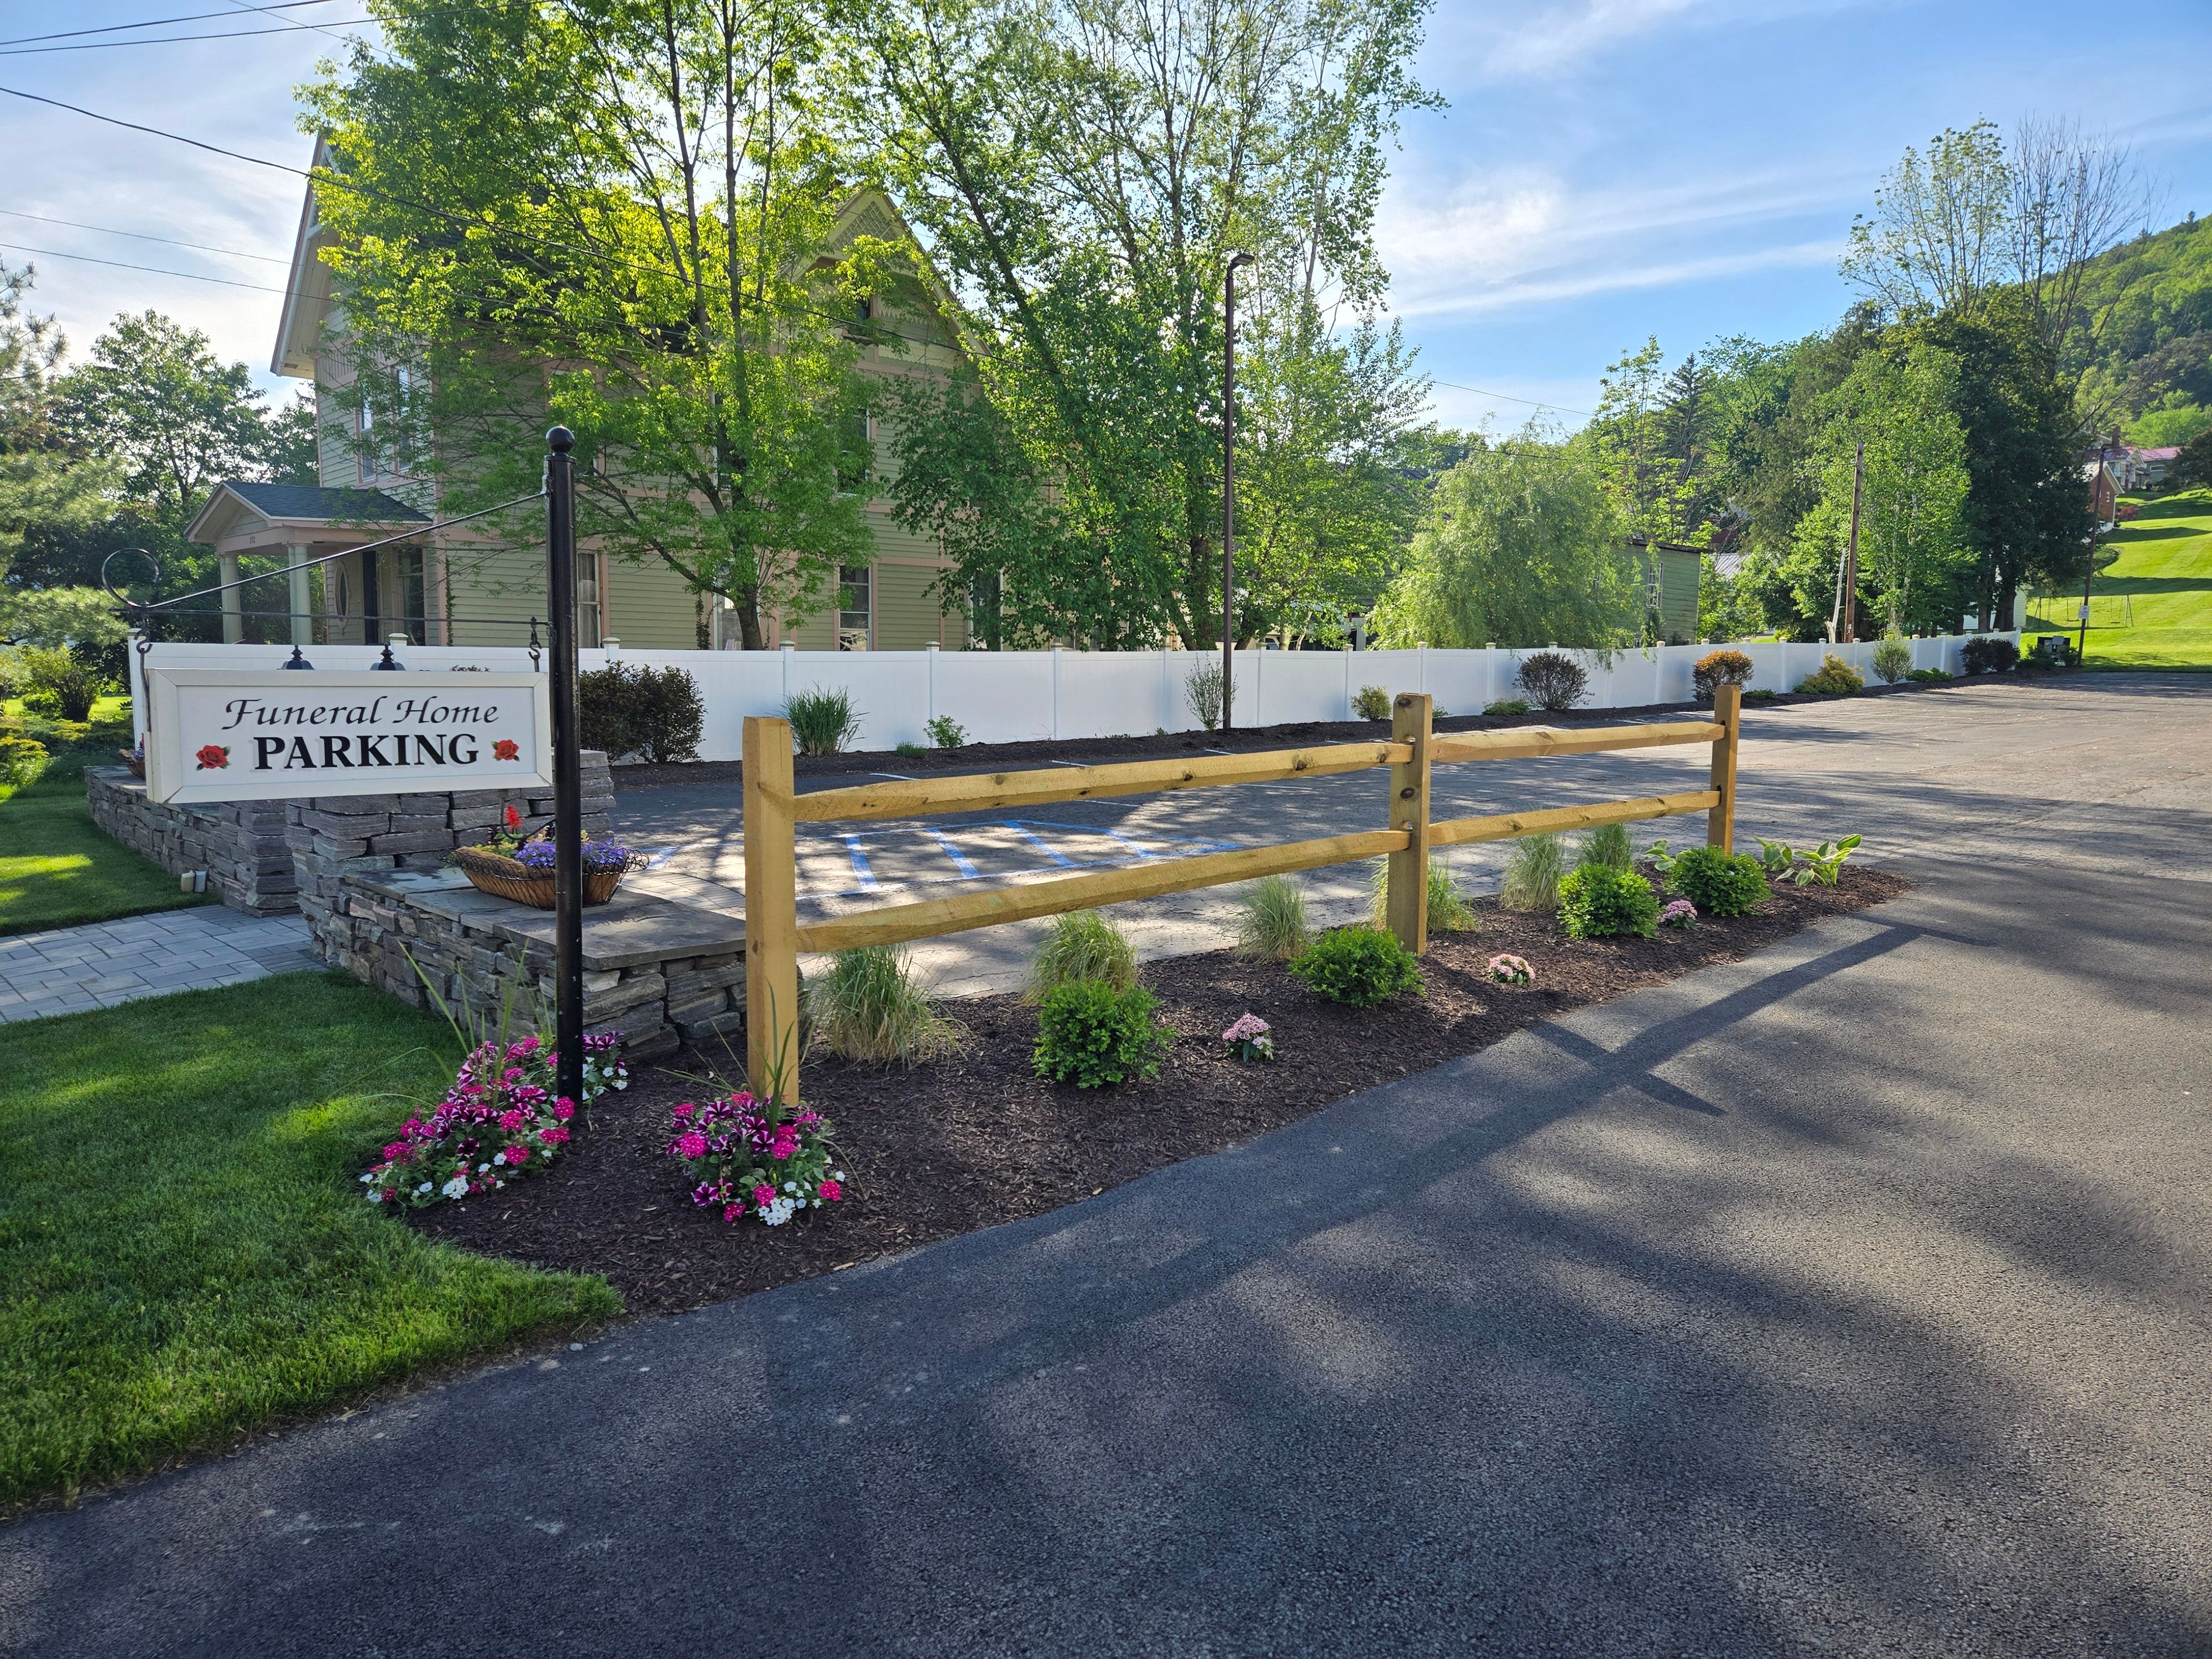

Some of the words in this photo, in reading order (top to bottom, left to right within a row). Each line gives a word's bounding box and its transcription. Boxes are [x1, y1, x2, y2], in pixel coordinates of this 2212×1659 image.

[222, 696, 388, 729] Funeral
[393, 696, 499, 724] Home
[253, 733, 479, 770] PARKING
